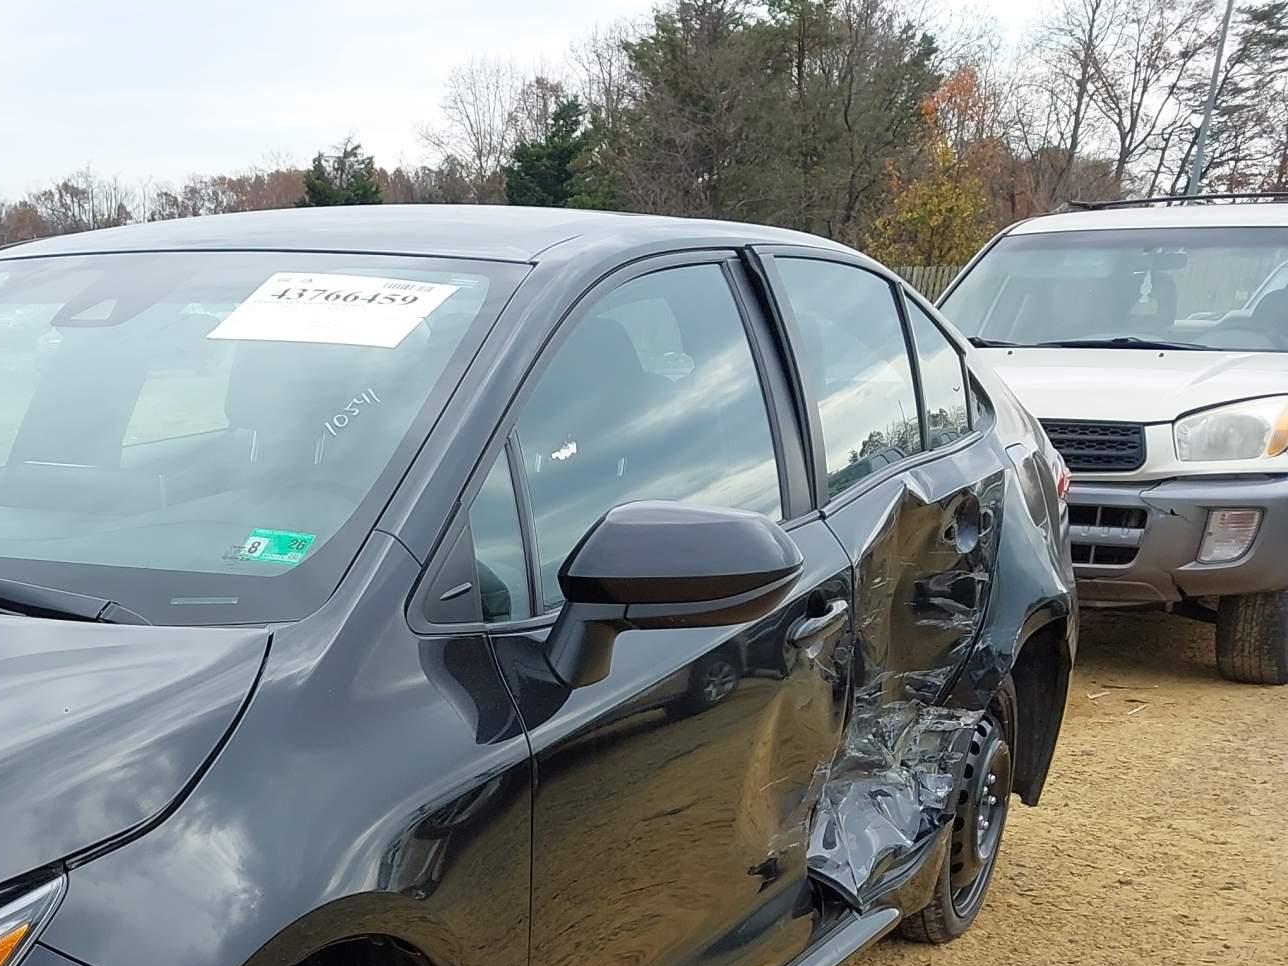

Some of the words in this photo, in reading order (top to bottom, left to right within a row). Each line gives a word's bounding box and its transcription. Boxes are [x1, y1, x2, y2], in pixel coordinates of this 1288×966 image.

[271, 288, 419, 305] 43766459
[325, 388, 380, 435] 10541
[248, 541, 261, 553] 8
[288, 539, 307, 550] 26
